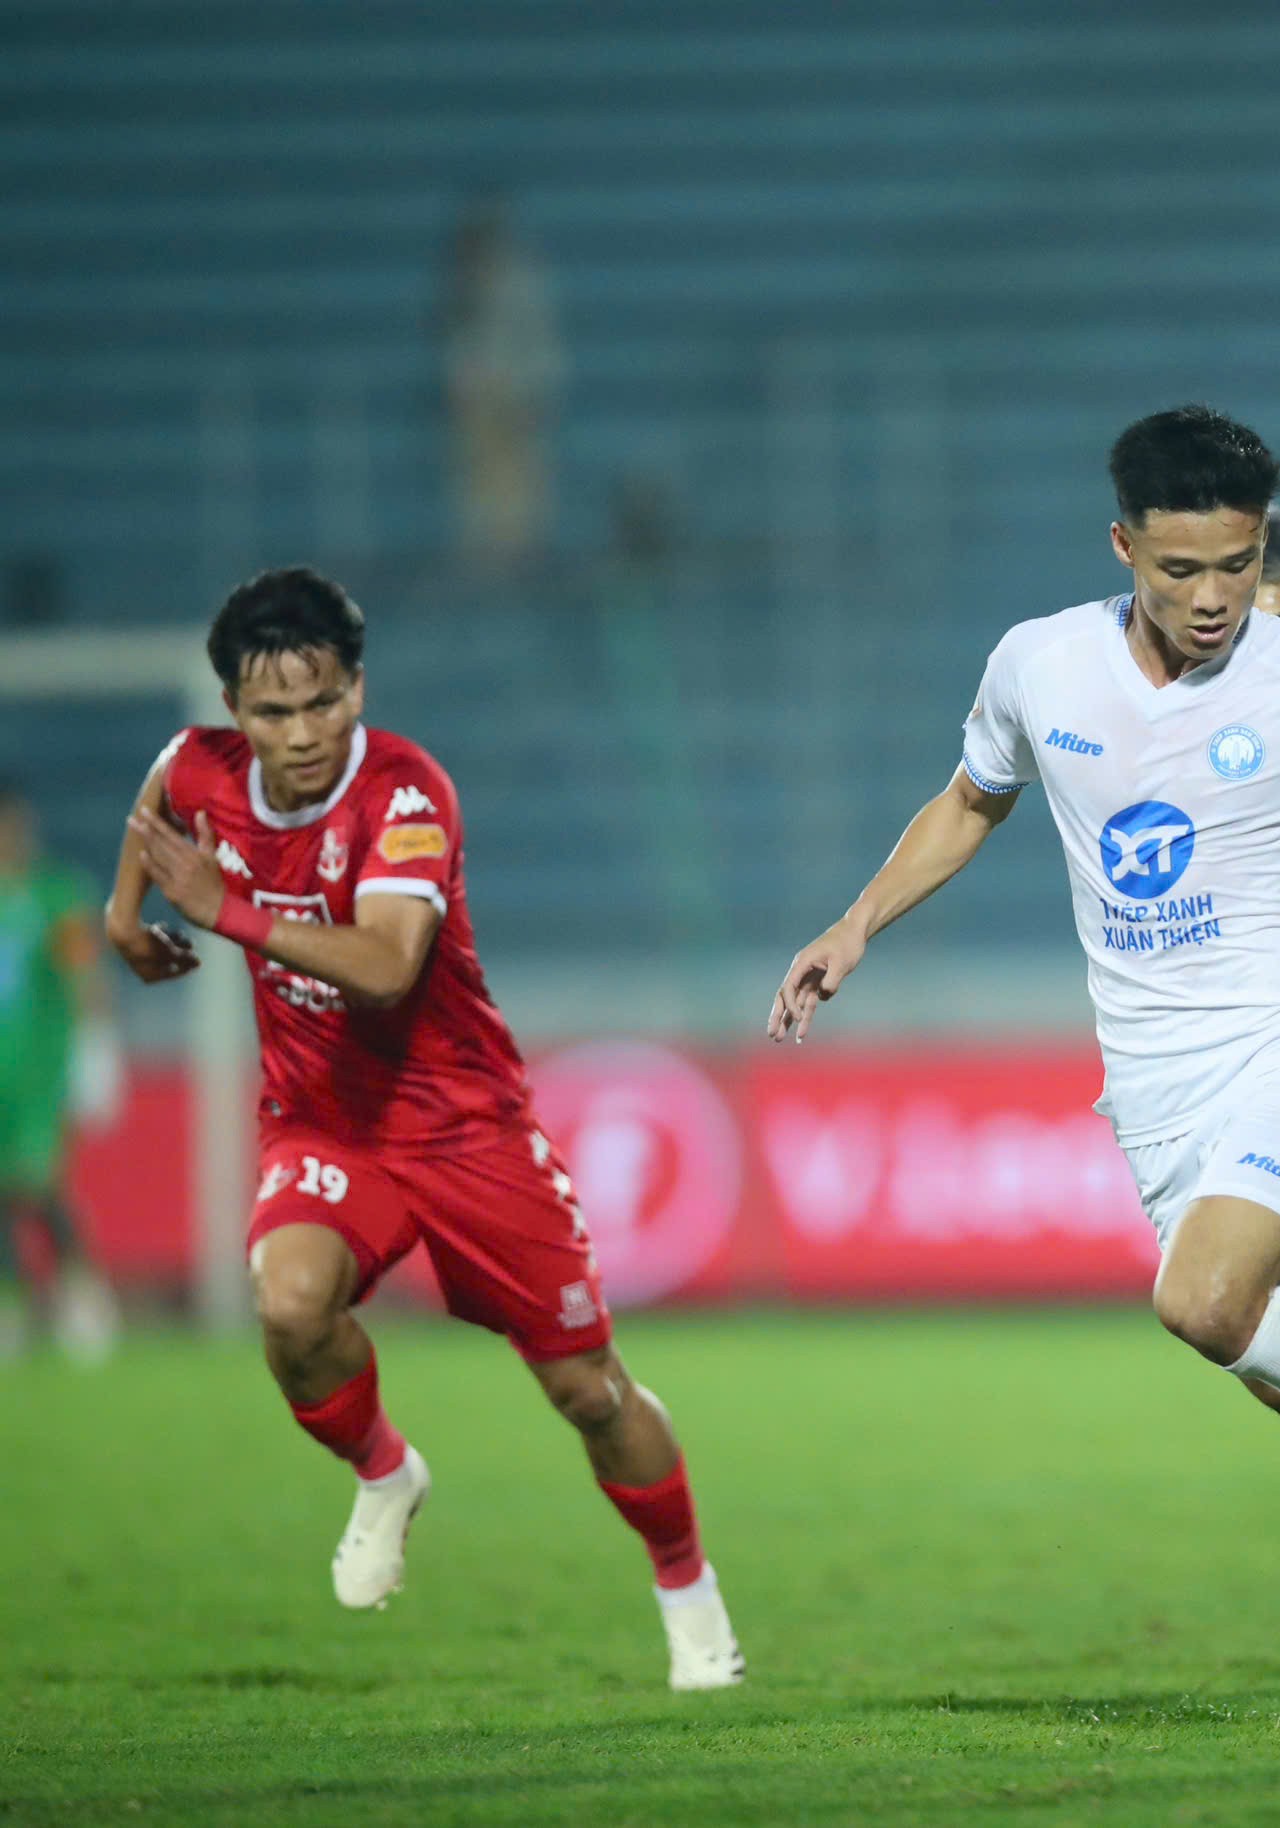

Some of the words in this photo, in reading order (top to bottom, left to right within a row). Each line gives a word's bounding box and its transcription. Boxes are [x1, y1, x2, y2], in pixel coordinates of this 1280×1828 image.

[1044, 727, 1104, 756] Mitre
[1155, 894, 1213, 923] XANH
[1102, 925, 1153, 951] XUÂN
[1158, 919, 1221, 950] THIỆN
[296, 1155, 349, 1204] 19
